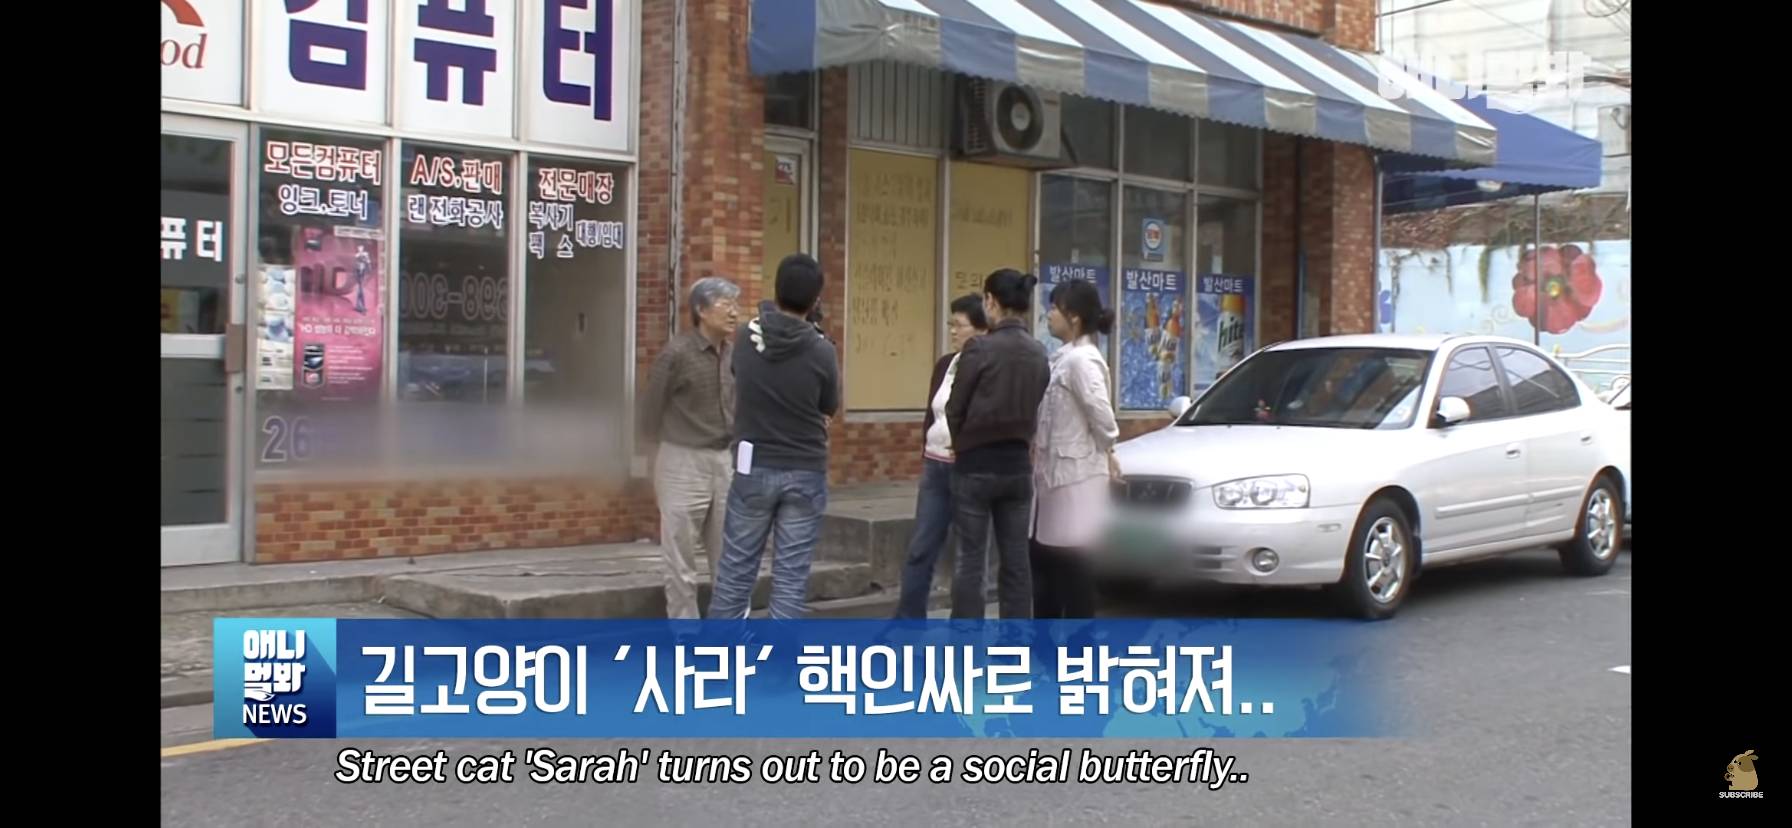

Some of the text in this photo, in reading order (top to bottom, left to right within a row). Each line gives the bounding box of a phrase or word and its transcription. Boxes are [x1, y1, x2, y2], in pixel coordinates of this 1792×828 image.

[264, 140, 382, 186] 모든컴퓨터
[410, 154, 502, 195] A/S.판매
[538, 168, 614, 205] 전문매장
[429, 198, 504, 229] 전화공사
[528, 201, 574, 231] 복사기
[1049, 264, 1098, 284] 발산마트
[1125, 269, 1178, 291] 발산마트
[1202, 276, 1244, 294] 발산마트
